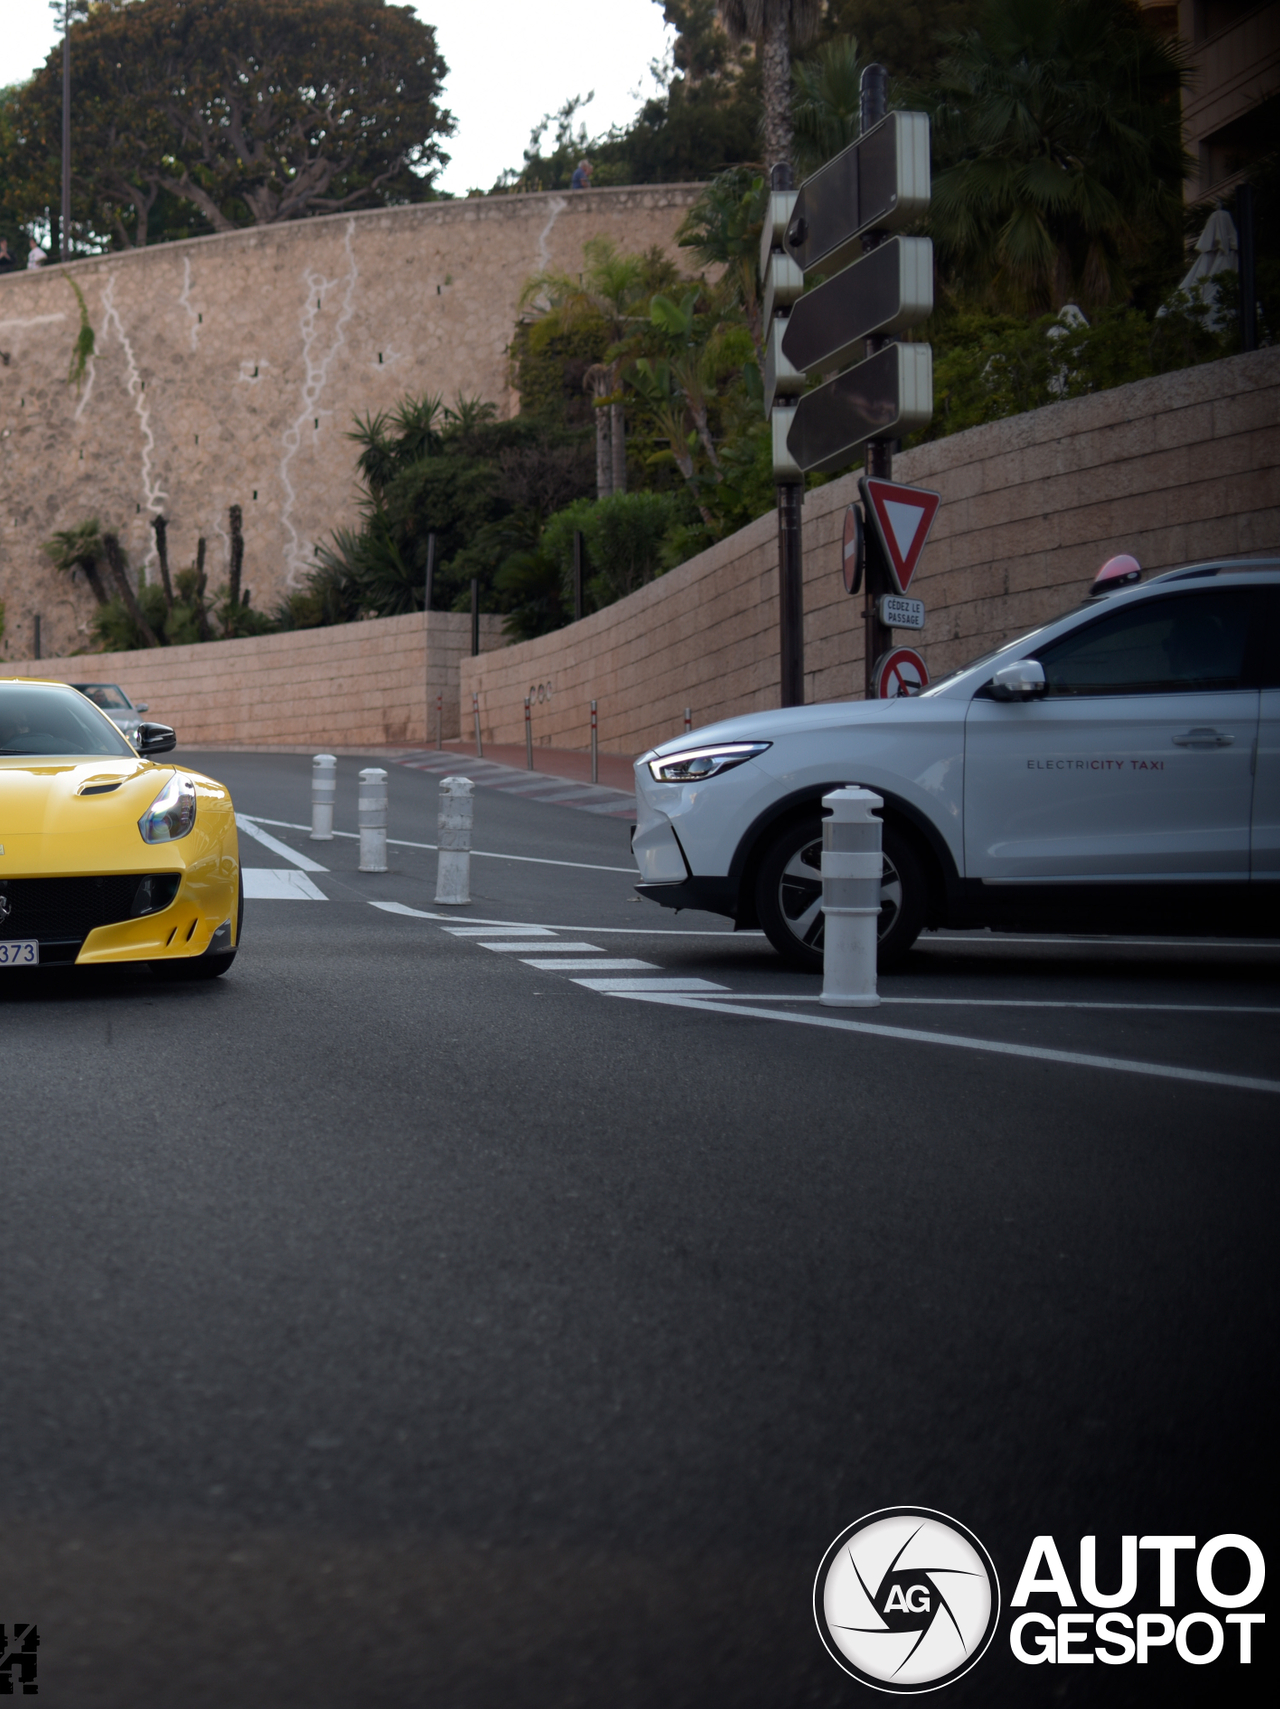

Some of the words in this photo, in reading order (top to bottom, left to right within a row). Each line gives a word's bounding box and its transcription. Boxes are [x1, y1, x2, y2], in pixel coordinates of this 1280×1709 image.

[887, 599, 910, 612] CÉDEZ
[912, 603, 921, 613] LE
[888, 612, 920, 625] PASSAGE
[1027, 760, 1124, 770] ELECTRICITY
[1130, 760, 1164, 771] TAXI
